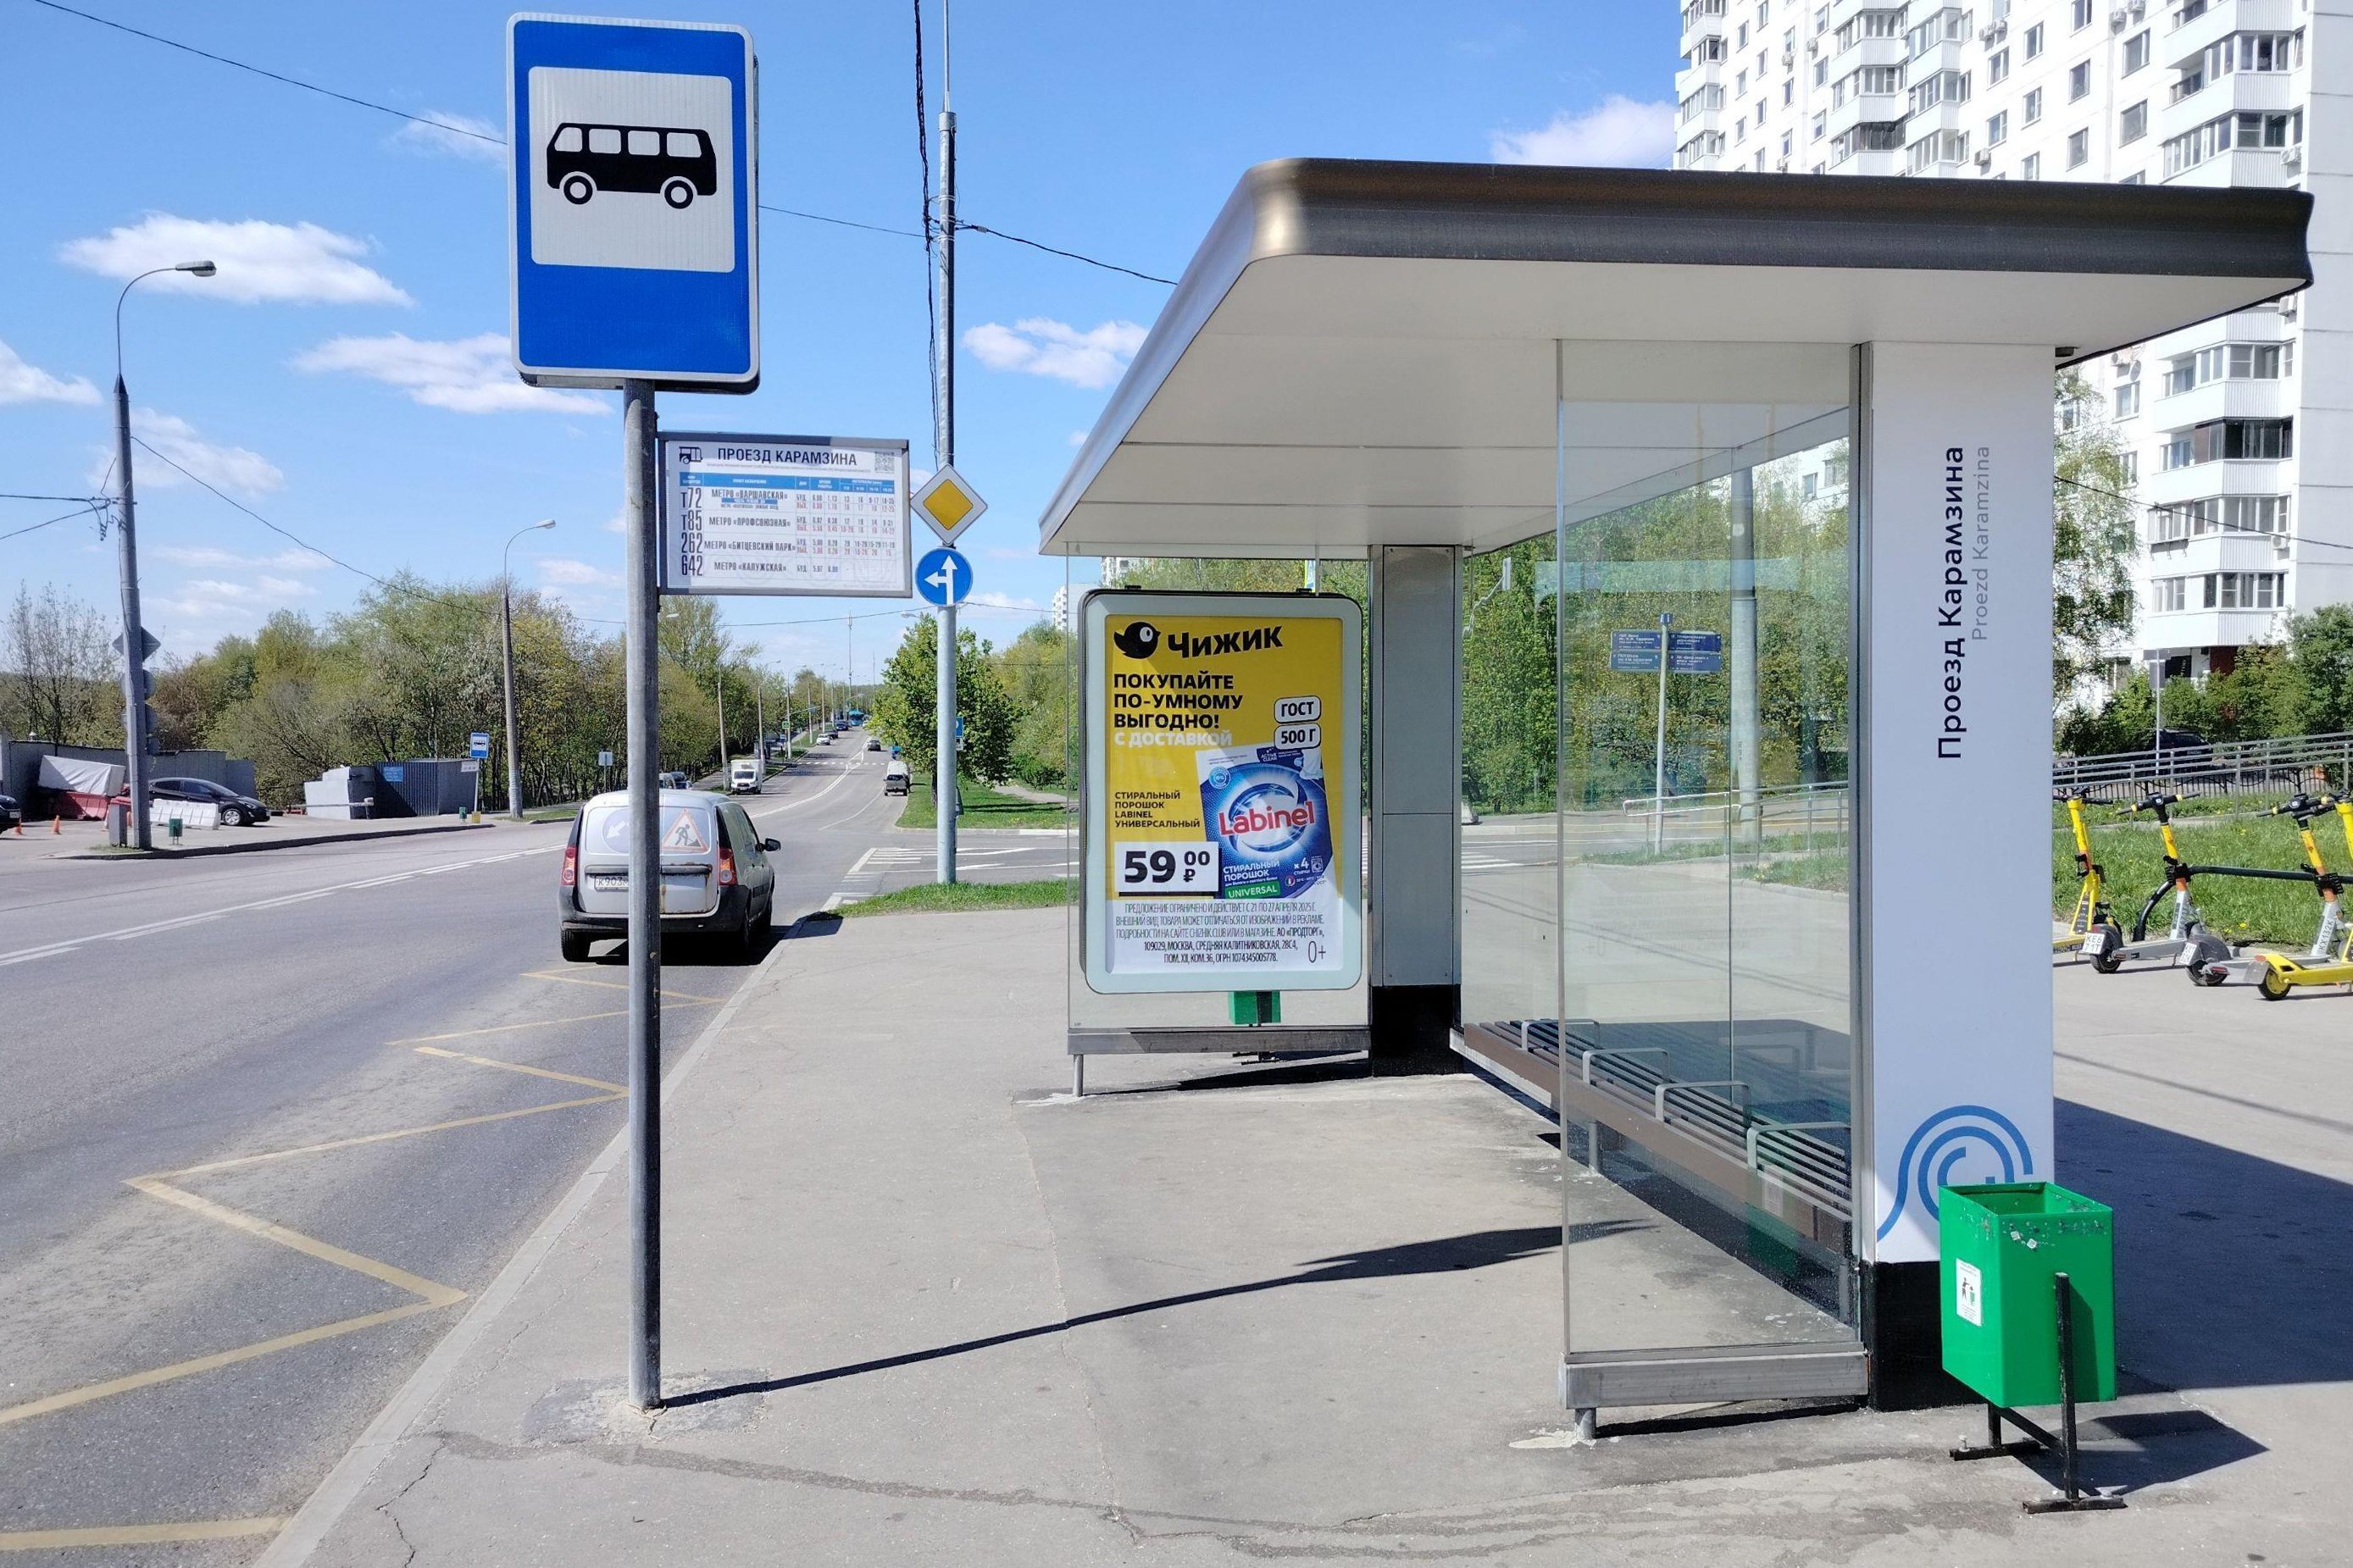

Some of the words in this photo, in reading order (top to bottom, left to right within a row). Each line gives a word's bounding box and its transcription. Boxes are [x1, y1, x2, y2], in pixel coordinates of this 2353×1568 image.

[718, 448, 772, 463] ПРОЕЗД
[776, 449, 857, 466] КАРАМЗИНА
[712, 489, 734, 497] МЕТРО
[1972, 446, 1990, 560] Karamzina
[709, 517, 731, 525] МЕТРО
[681, 532, 702, 553] 262
[1938, 446, 1968, 626] Карамзина
[704, 540, 727, 549] МЕТРО
[681, 555, 702, 576] 642
[714, 562, 737, 570] МЕТРО
[738, 562, 786, 572] «КАЛУЖСКАЯ»
[1972, 568, 1989, 640] Proezd
[1113, 670, 1234, 690] ПОКУПАЙТЕ
[1113, 693, 1243, 710] ПО-УМНОМУ
[1938, 637, 1967, 758] Проезд
[1280, 701, 1314, 717] ГОСТ
[1113, 713, 1220, 731] ВЫГОДНО!
[1114, 732, 1125, 745] С
[1128, 729, 1232, 747] ДОСТАВКОЙ
[1280, 729, 1306, 745] 500
[1115, 790, 1180, 800] СТИРАЛЬНЫЙ
[1115, 817, 1201, 828] УНИВЕРСАЛЬНЫЙ
[1218, 801, 1316, 837] Labinel
[1124, 850, 1176, 884] 59
[1184, 850, 1210, 866] 00
[1223, 859, 1280, 874] СТИРАЛЬНЫЙ
[1224, 869, 1269, 882] ПОРОШОК
[1229, 884, 1278, 898] UNIVERSAL
[1125, 903, 1168, 914] ПРЕДЛОЖЕНИЕ
[1170, 903, 1207, 912] ОГРАНИЧЕНО
[1213, 900, 1245, 913] ДЕЙСТВУЕТ
[1268, 902, 1274, 911] 27
[1275, 902, 1299, 911] АПРЕЛЯ
[1299, 902, 1312, 911] 2025
[1160, 917, 1181, 925] ТОВАРА
[1183, 916, 1203, 925] МОЖЕТ
[1204, 916, 1240, 925] ОТЛИЧАТЬСЯ
[1241, 916, 1248, 924] ОТ
[1249, 912, 1291, 924] ИЗОБРАЖЕНИЙ
[1117, 928, 1160, 939] ПОДРОБНОСТИ
[1161, 928, 1169, 938] НА
[1171, 926, 1189, 938] САЙТЕ
[1227, 928, 1240, 937] ИЛИ
[1277, 928, 1285, 936] АО
[1144, 941, 1166, 951] 109029,
[1168, 941, 1195, 951] МОСКВА,
[1196, 940, 1223, 951] СРЕДНЯЯ
[1308, 940, 1326, 963] 0+
[1216, 953, 1231, 962] ОГРН
